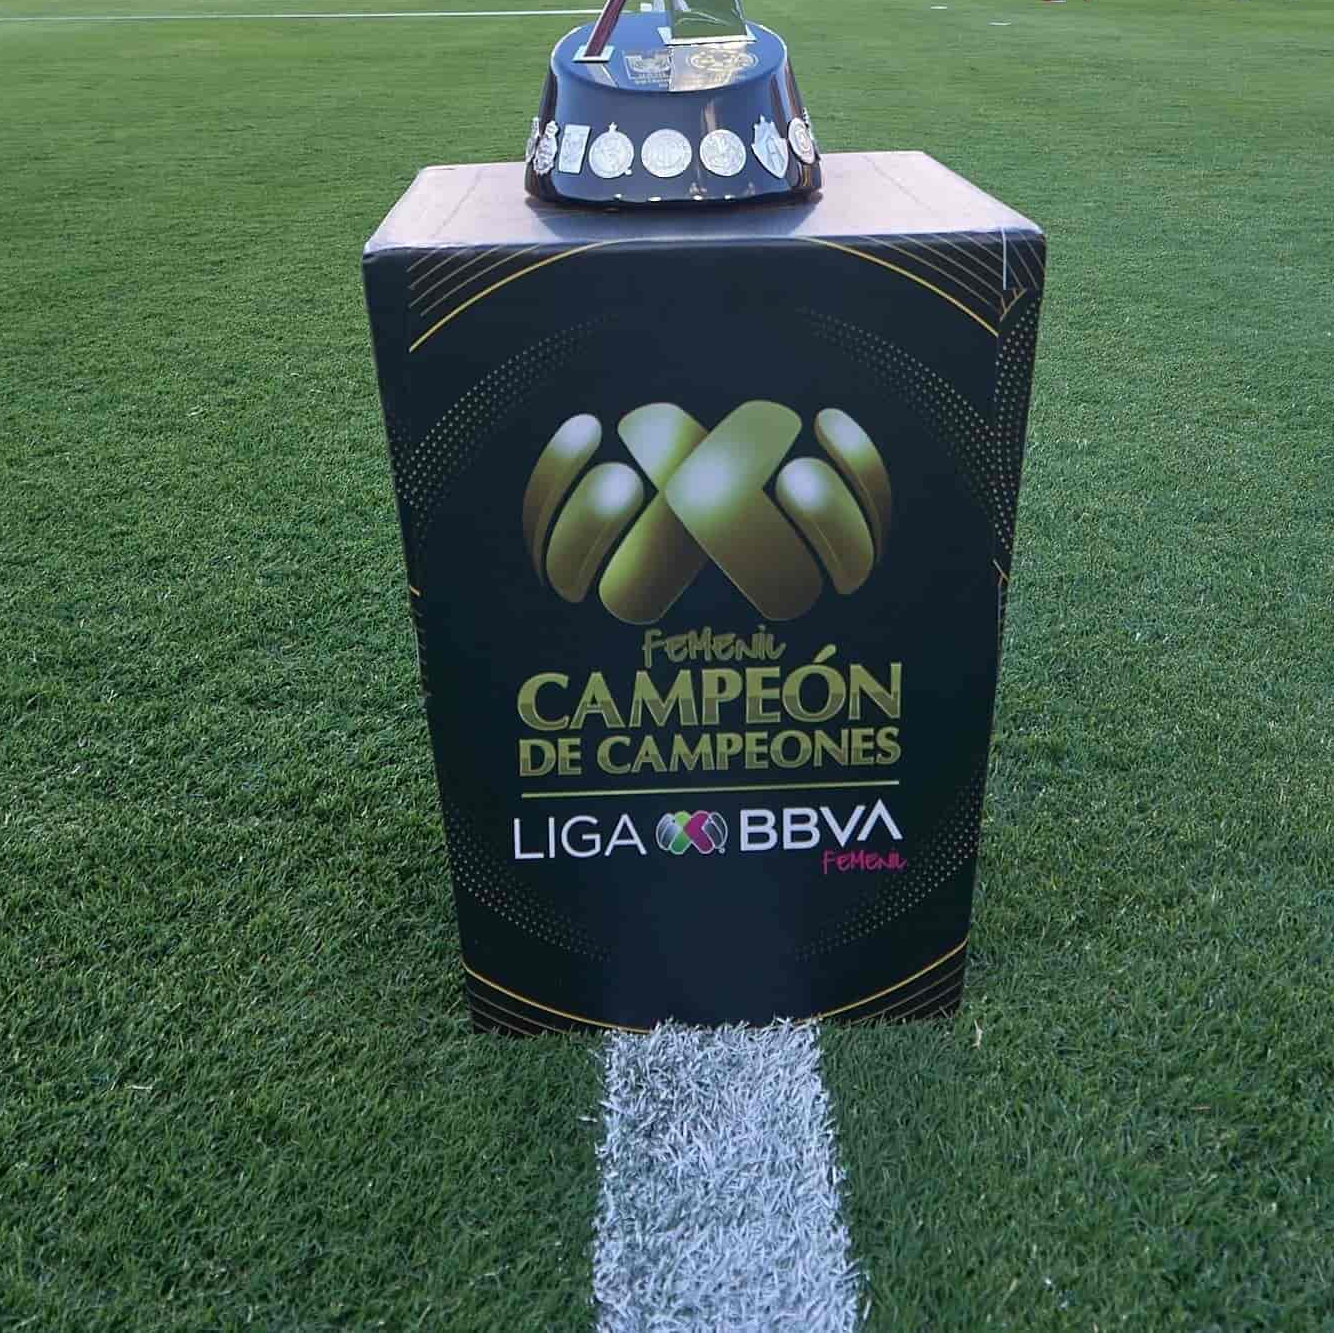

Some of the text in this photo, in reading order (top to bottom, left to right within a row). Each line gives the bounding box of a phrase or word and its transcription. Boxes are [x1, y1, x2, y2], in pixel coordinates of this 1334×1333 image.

[516, 644, 903, 731] CAMPEÓN
[518, 726, 902, 777] DE CAMPEONES
[513, 798, 904, 860] LIGA BBVA
